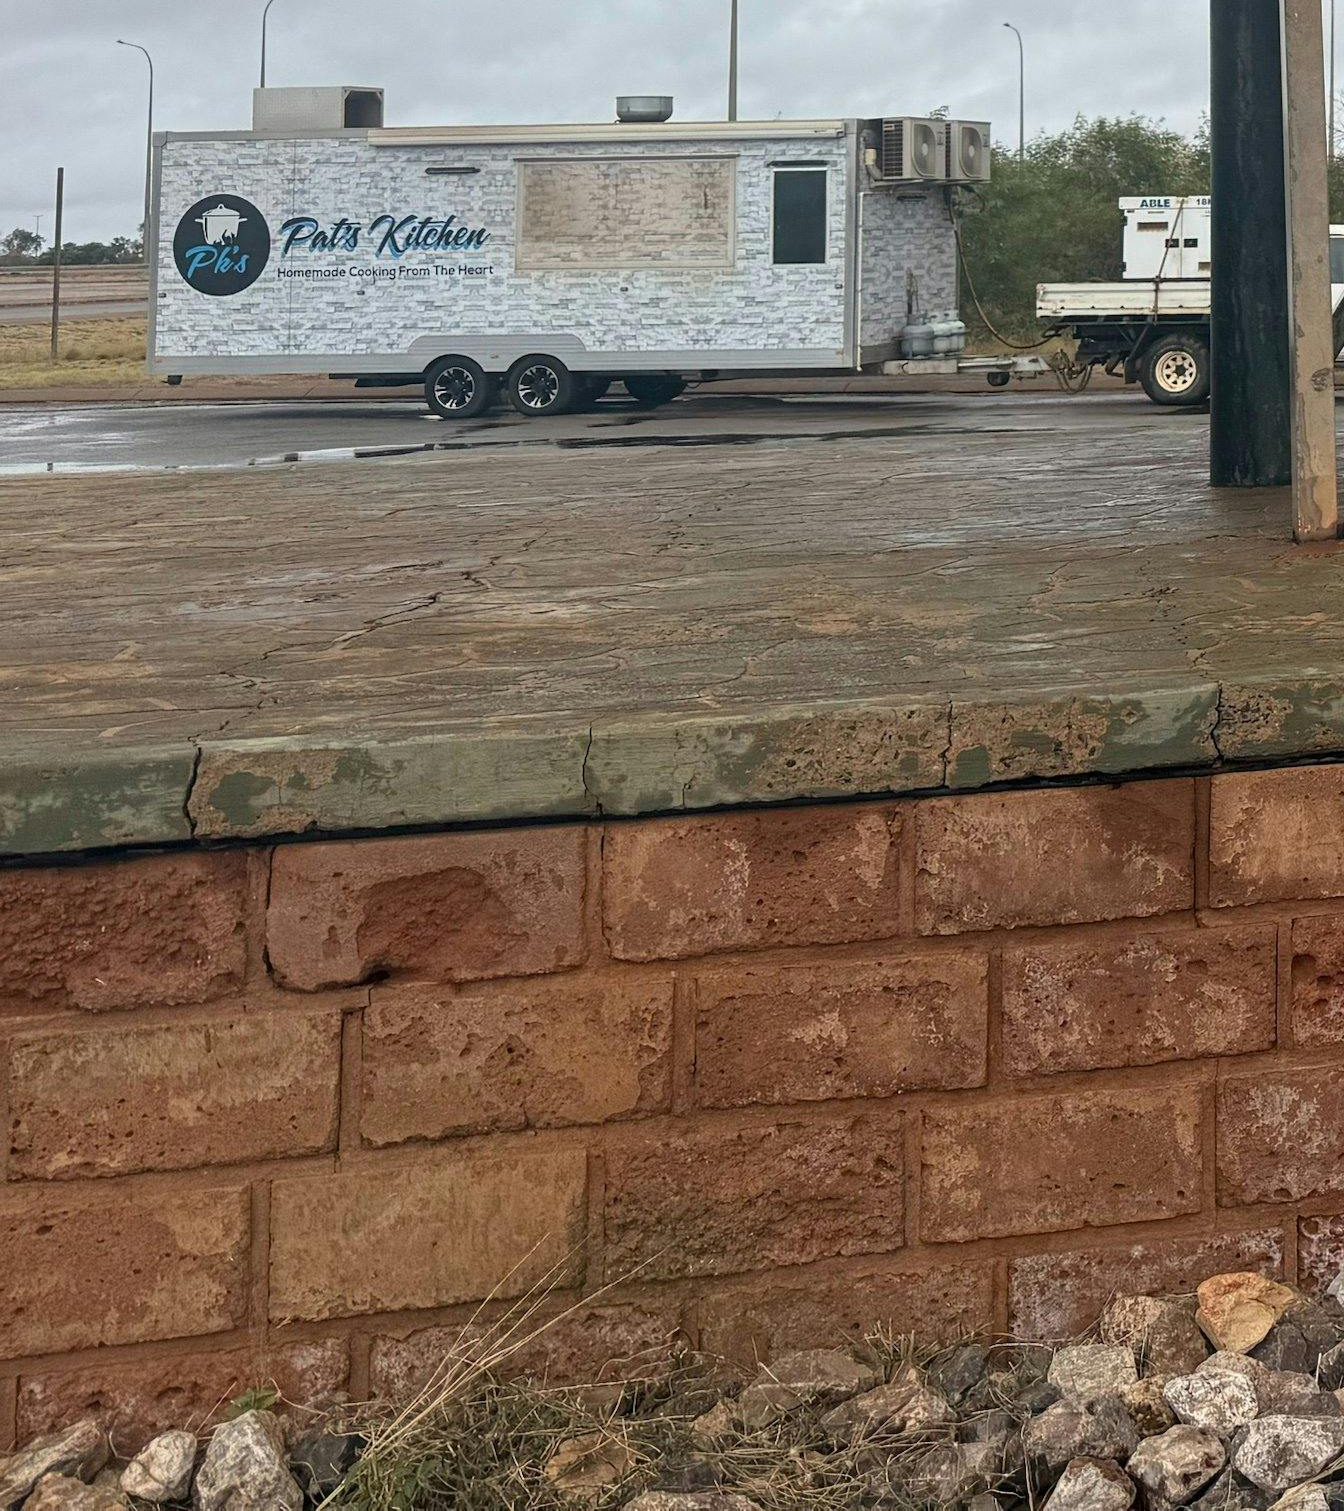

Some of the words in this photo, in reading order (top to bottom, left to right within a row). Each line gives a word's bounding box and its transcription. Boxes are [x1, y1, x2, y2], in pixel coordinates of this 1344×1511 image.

[1140, 199, 1170, 208] ABLE
[279, 216, 362, 258] Pat's
[368, 215, 491, 259] Kitchen
[185, 245, 250, 279] Pk's
[277, 266, 346, 278] Homemade
[349, 265, 396, 280] Cooking
[399, 265, 430, 276] From
[433, 264, 455, 275] The
[458, 264, 494, 275] Heart
